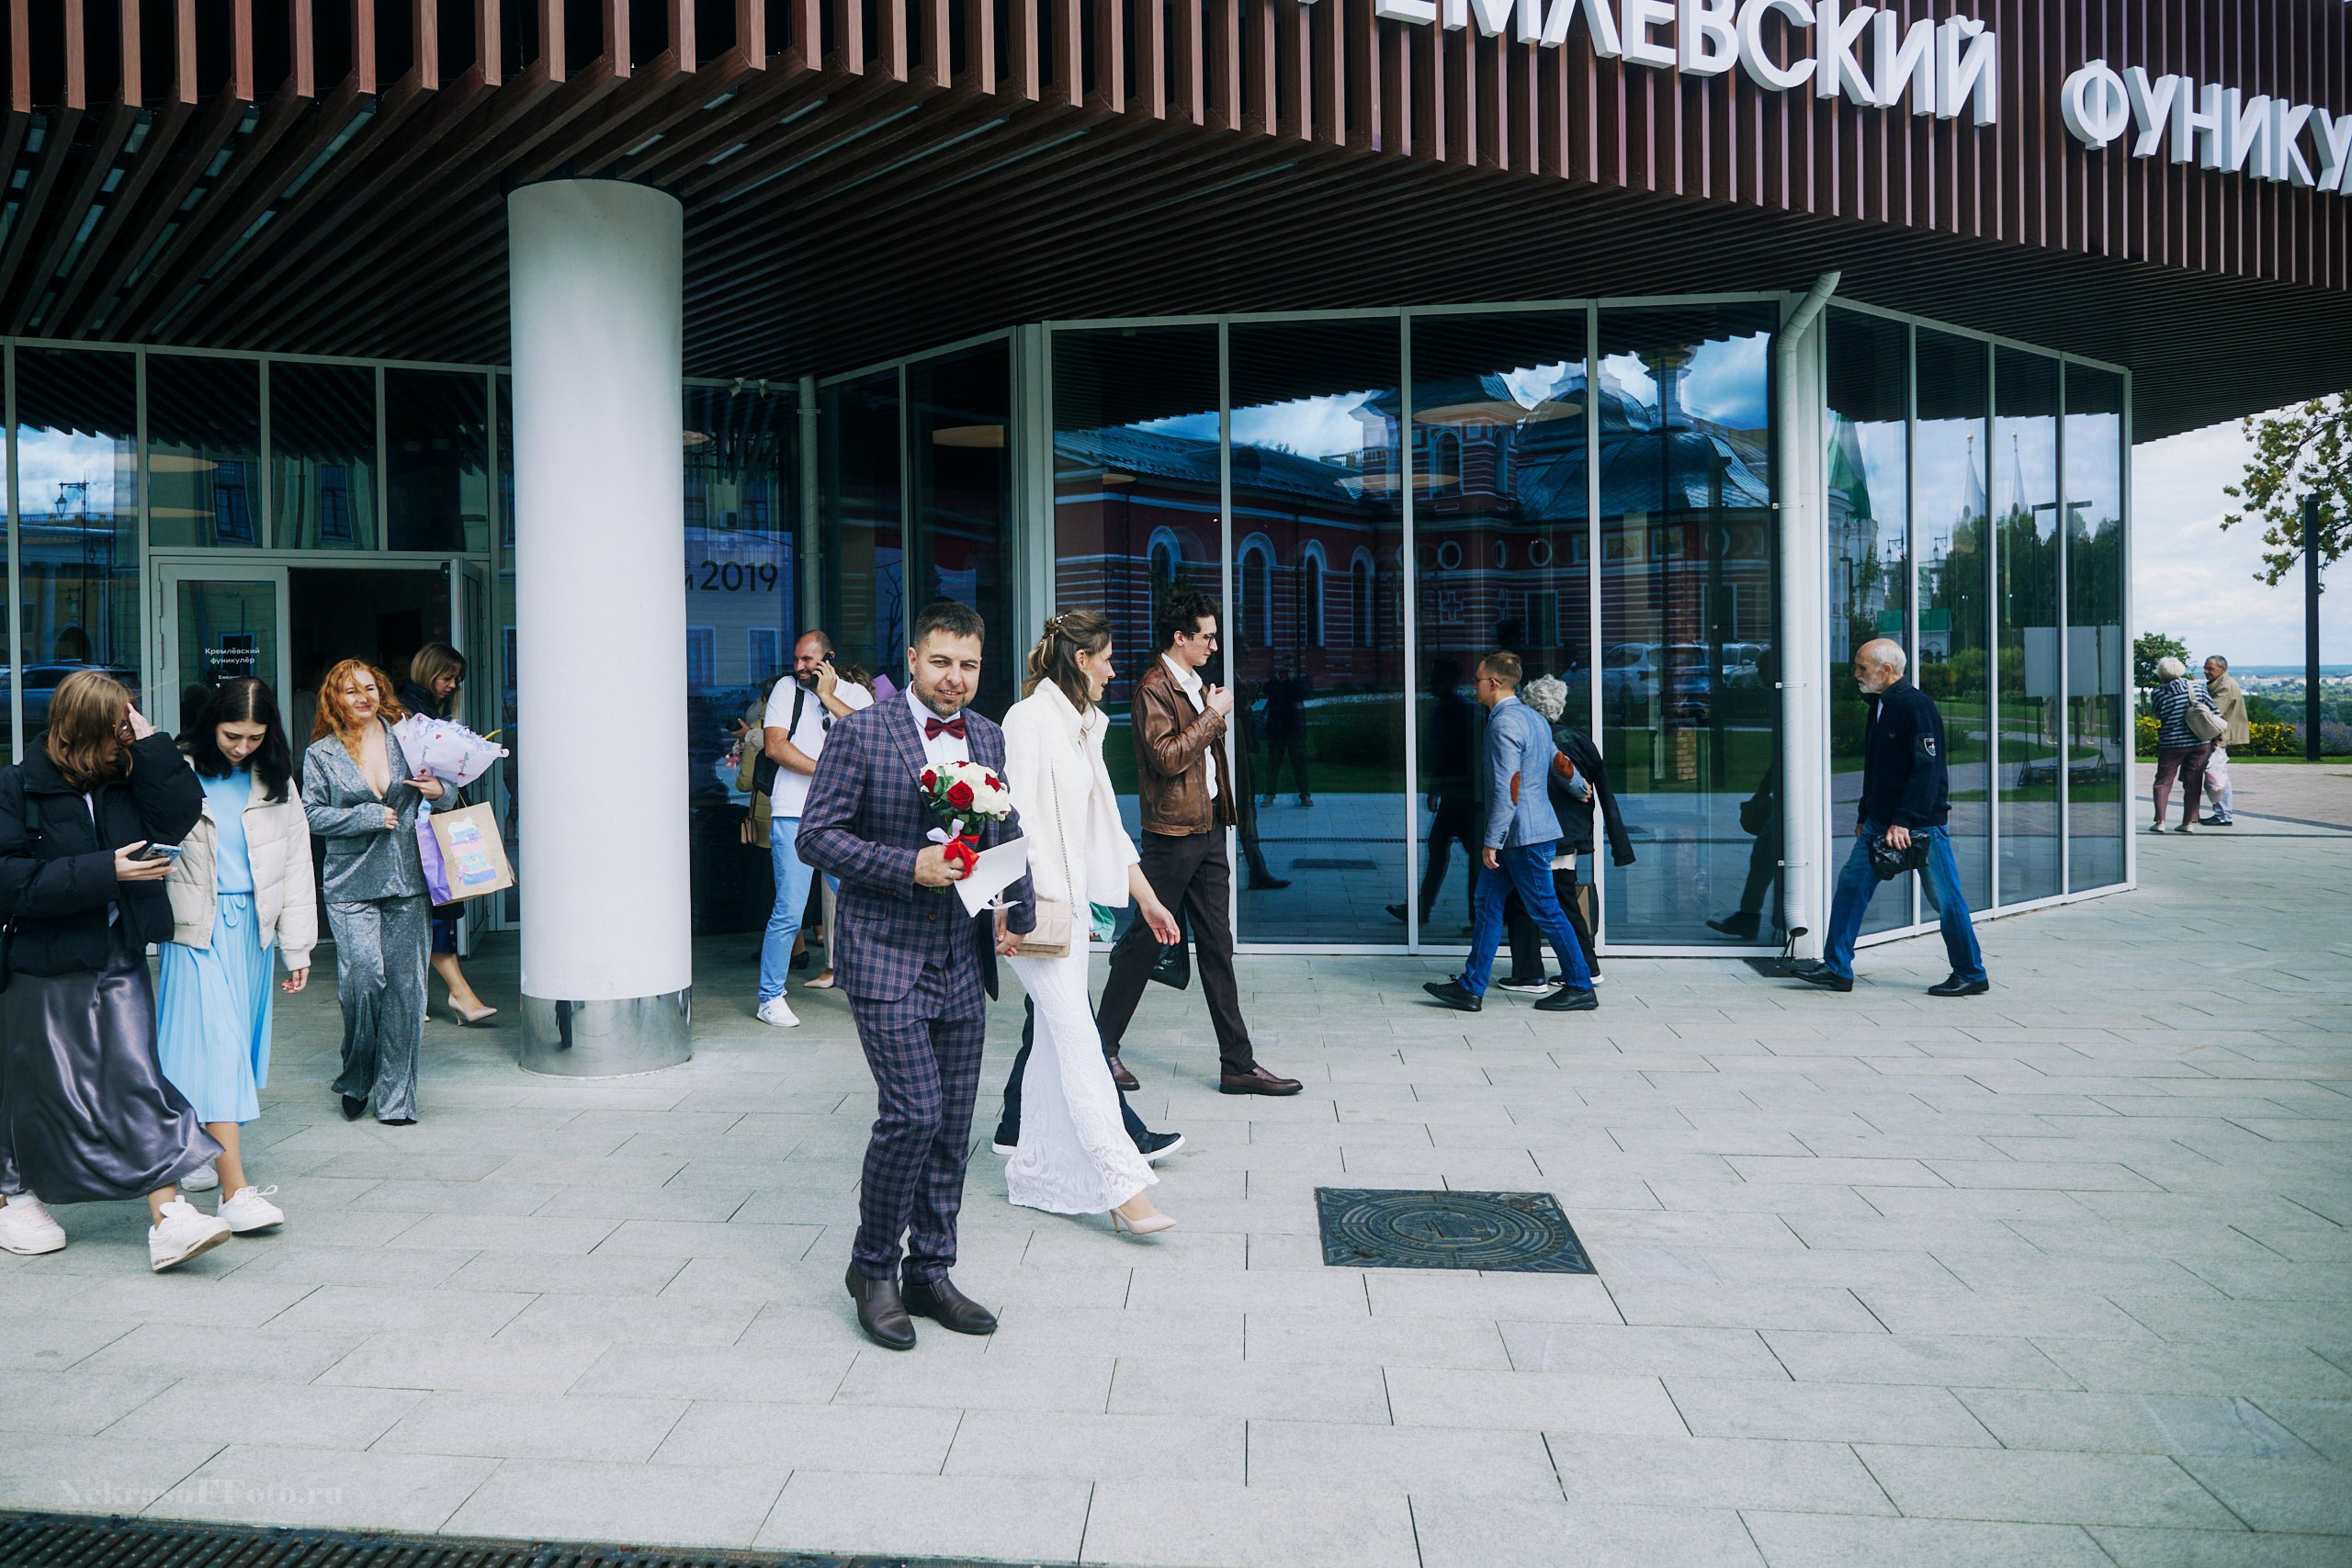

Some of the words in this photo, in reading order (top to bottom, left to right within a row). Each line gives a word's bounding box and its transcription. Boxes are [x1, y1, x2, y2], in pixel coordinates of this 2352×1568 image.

[2061, 59, 2352, 197] ФУНИКУ
[700, 559, 778, 592] 2019
[205, 647, 260, 656] Кремлёвский
[210, 656, 255, 665] фуникулёр
